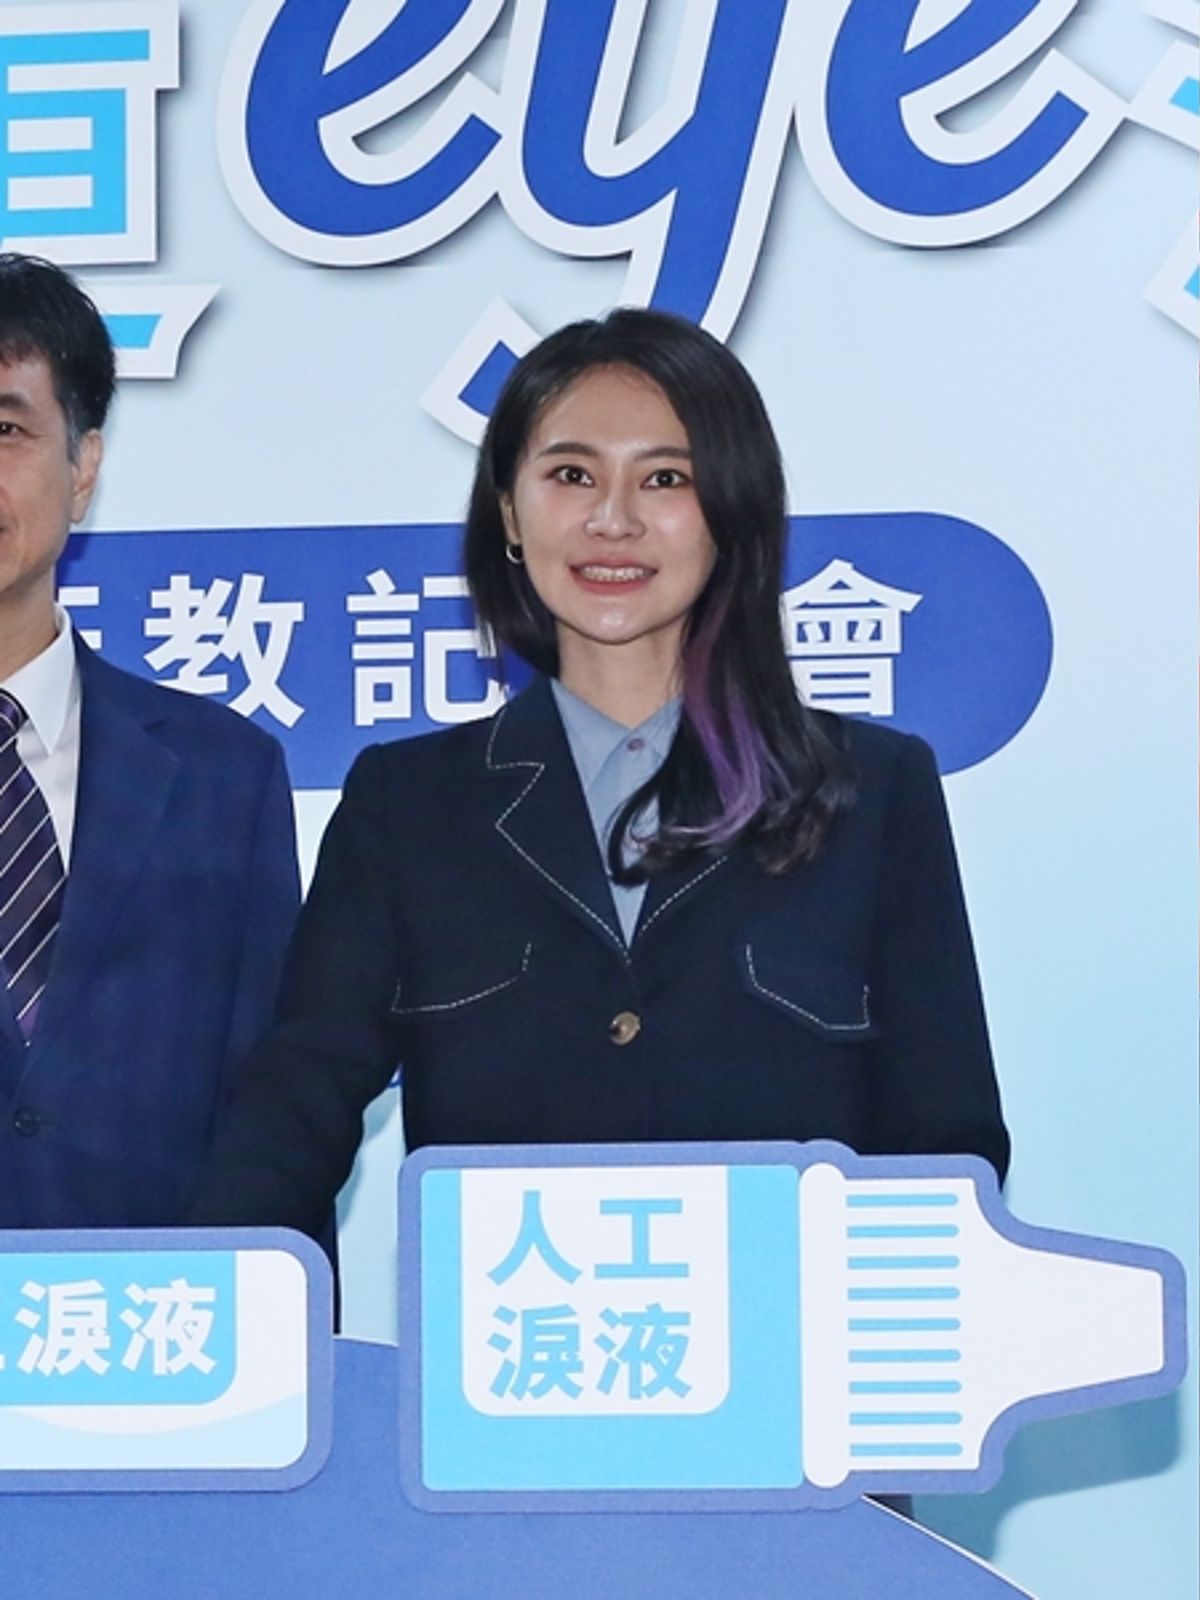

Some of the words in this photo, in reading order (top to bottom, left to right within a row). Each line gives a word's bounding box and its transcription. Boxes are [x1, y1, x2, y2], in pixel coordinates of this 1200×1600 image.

[58, 555, 923, 728] 教記會
[486, 1189, 691, 1286] 人工
[0, 1278, 217, 1377] 淚液
[486, 1302, 693, 1401] 淚液
